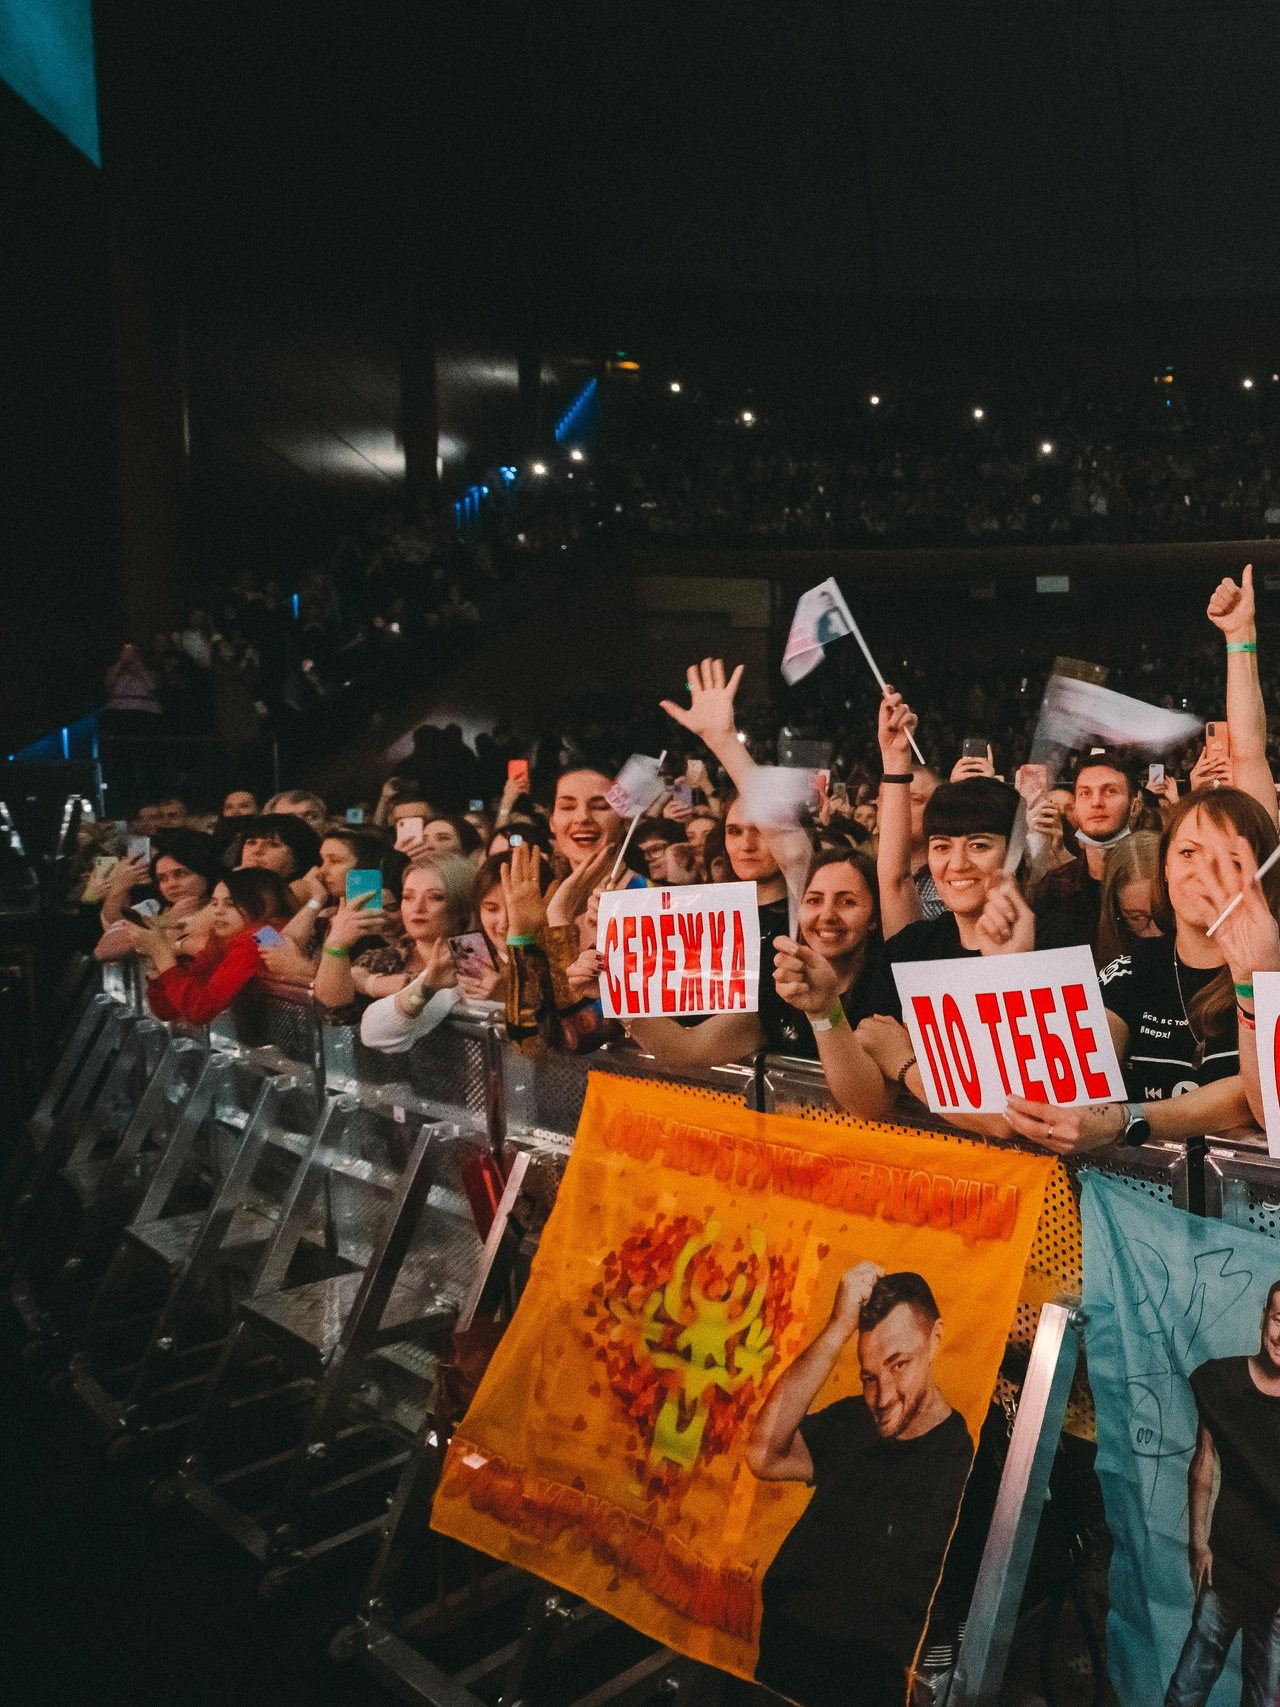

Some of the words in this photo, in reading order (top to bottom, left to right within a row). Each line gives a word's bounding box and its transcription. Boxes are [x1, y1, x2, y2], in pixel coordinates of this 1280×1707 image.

[605, 892, 746, 1015] СЕРЁЖКА
[911, 993, 982, 1110] ПО
[975, 984, 1111, 1104] ТЕБЕ
